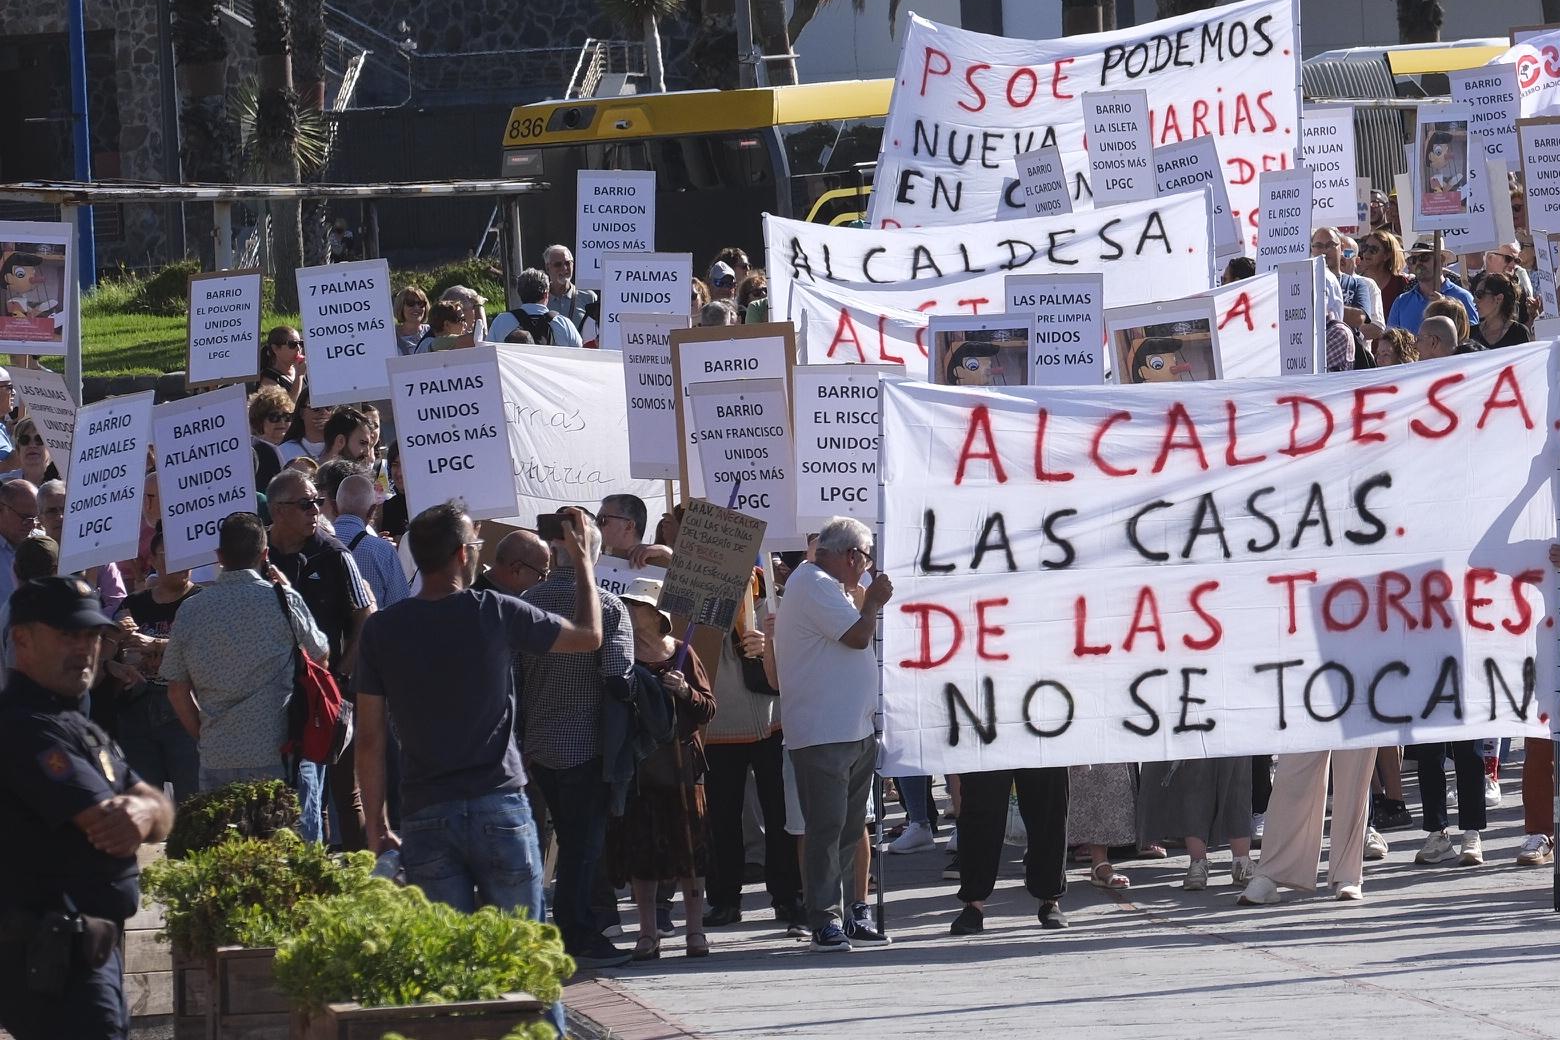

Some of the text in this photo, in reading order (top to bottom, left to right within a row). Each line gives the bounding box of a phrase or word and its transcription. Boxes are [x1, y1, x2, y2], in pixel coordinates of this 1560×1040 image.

[920, 45, 1074, 113] PSOE
[1465, 78, 1502, 91] BARRIO
[1096, 104, 1132, 115] BARRIO
[509, 118, 544, 139] 836
[1094, 122, 1138, 134] LA ISLETA
[1100, 141, 1137, 152] UNIDOS
[1093, 157, 1147, 170] SOMOS MÁS
[1529, 154, 1536, 164] EL
[1027, 164, 1052, 178] BARRIO
[898, 168, 962, 211] EN
[1025, 180, 1062, 197] EL CARDON
[1106, 178, 1134, 190] LPGC
[594, 186, 636, 197] BARRIO
[1271, 189, 1300, 201] BARRIO
[1529, 186, 1560, 198] SOMOS
[584, 204, 646, 215] EL CARDON
[1035, 199, 1062, 213] UNIDOS
[1268, 207, 1301, 219] EL RISCO
[592, 222, 636, 233] UNIDOS
[1269, 226, 1299, 238] UNIDOS
[582, 237, 646, 250] SOMOS MÁS
[1260, 242, 1305, 256] SOMOS MÁS
[615, 270, 677, 282] 7 PALMAS
[321, 278, 374, 294] PALMAS
[1290, 283, 1301, 296] LOS
[206, 288, 242, 300] BARRIO
[620, 292, 671, 304] UNIDOS
[1013, 293, 1091, 306] LAS PALMAS
[196, 302, 251, 316] EL POLVORIN
[319, 300, 370, 316] UNIDOS
[1285, 307, 1307, 321] BARRIOS
[205, 318, 241, 329] UNIDOS
[1058, 313, 1092, 324] LIMPIA
[309, 318, 384, 338] SOMOS MÁS
[193, 331, 252, 347] SOMOS MÁS
[1290, 332, 1303, 345] LPGC
[208, 350, 230, 360] LPGC
[326, 342, 365, 359] LPGC
[1287, 358, 1307, 371] CON LAS
[405, 375, 484, 396] 7 PALMAS
[417, 402, 480, 421] UNIDOS
[716, 404, 763, 418] BARRIO
[814, 412, 831, 424] EL
[88, 414, 131, 435] BARRIO
[173, 415, 225, 439] BARRIO
[407, 425, 497, 447] SOMOS MÁS
[701, 426, 784, 441] SAN FRANCISCO
[79, 438, 136, 463] ARENALES
[164, 437, 239, 468] ATLÁNTICO
[725, 448, 769, 460] UNIDOS
[428, 454, 475, 474] LPGC
[802, 462, 857, 474] SOMOS
[82, 464, 127, 487] UNIDOS
[178, 465, 232, 490] UNIDOS
[759, 467, 785, 480] MÁS
[70, 487, 135, 514] SOMOS MÁS
[168, 485, 247, 517] SOMOS MÁS
[820, 487, 868, 503] LPGC
[79, 516, 113, 538] LPGC
[920, 506, 1078, 575] LAS
[900, 597, 1009, 670] DE
[1074, 580, 1223, 656] LAS
[946, 676, 1074, 748] NO
[1123, 668, 1215, 736] SE
